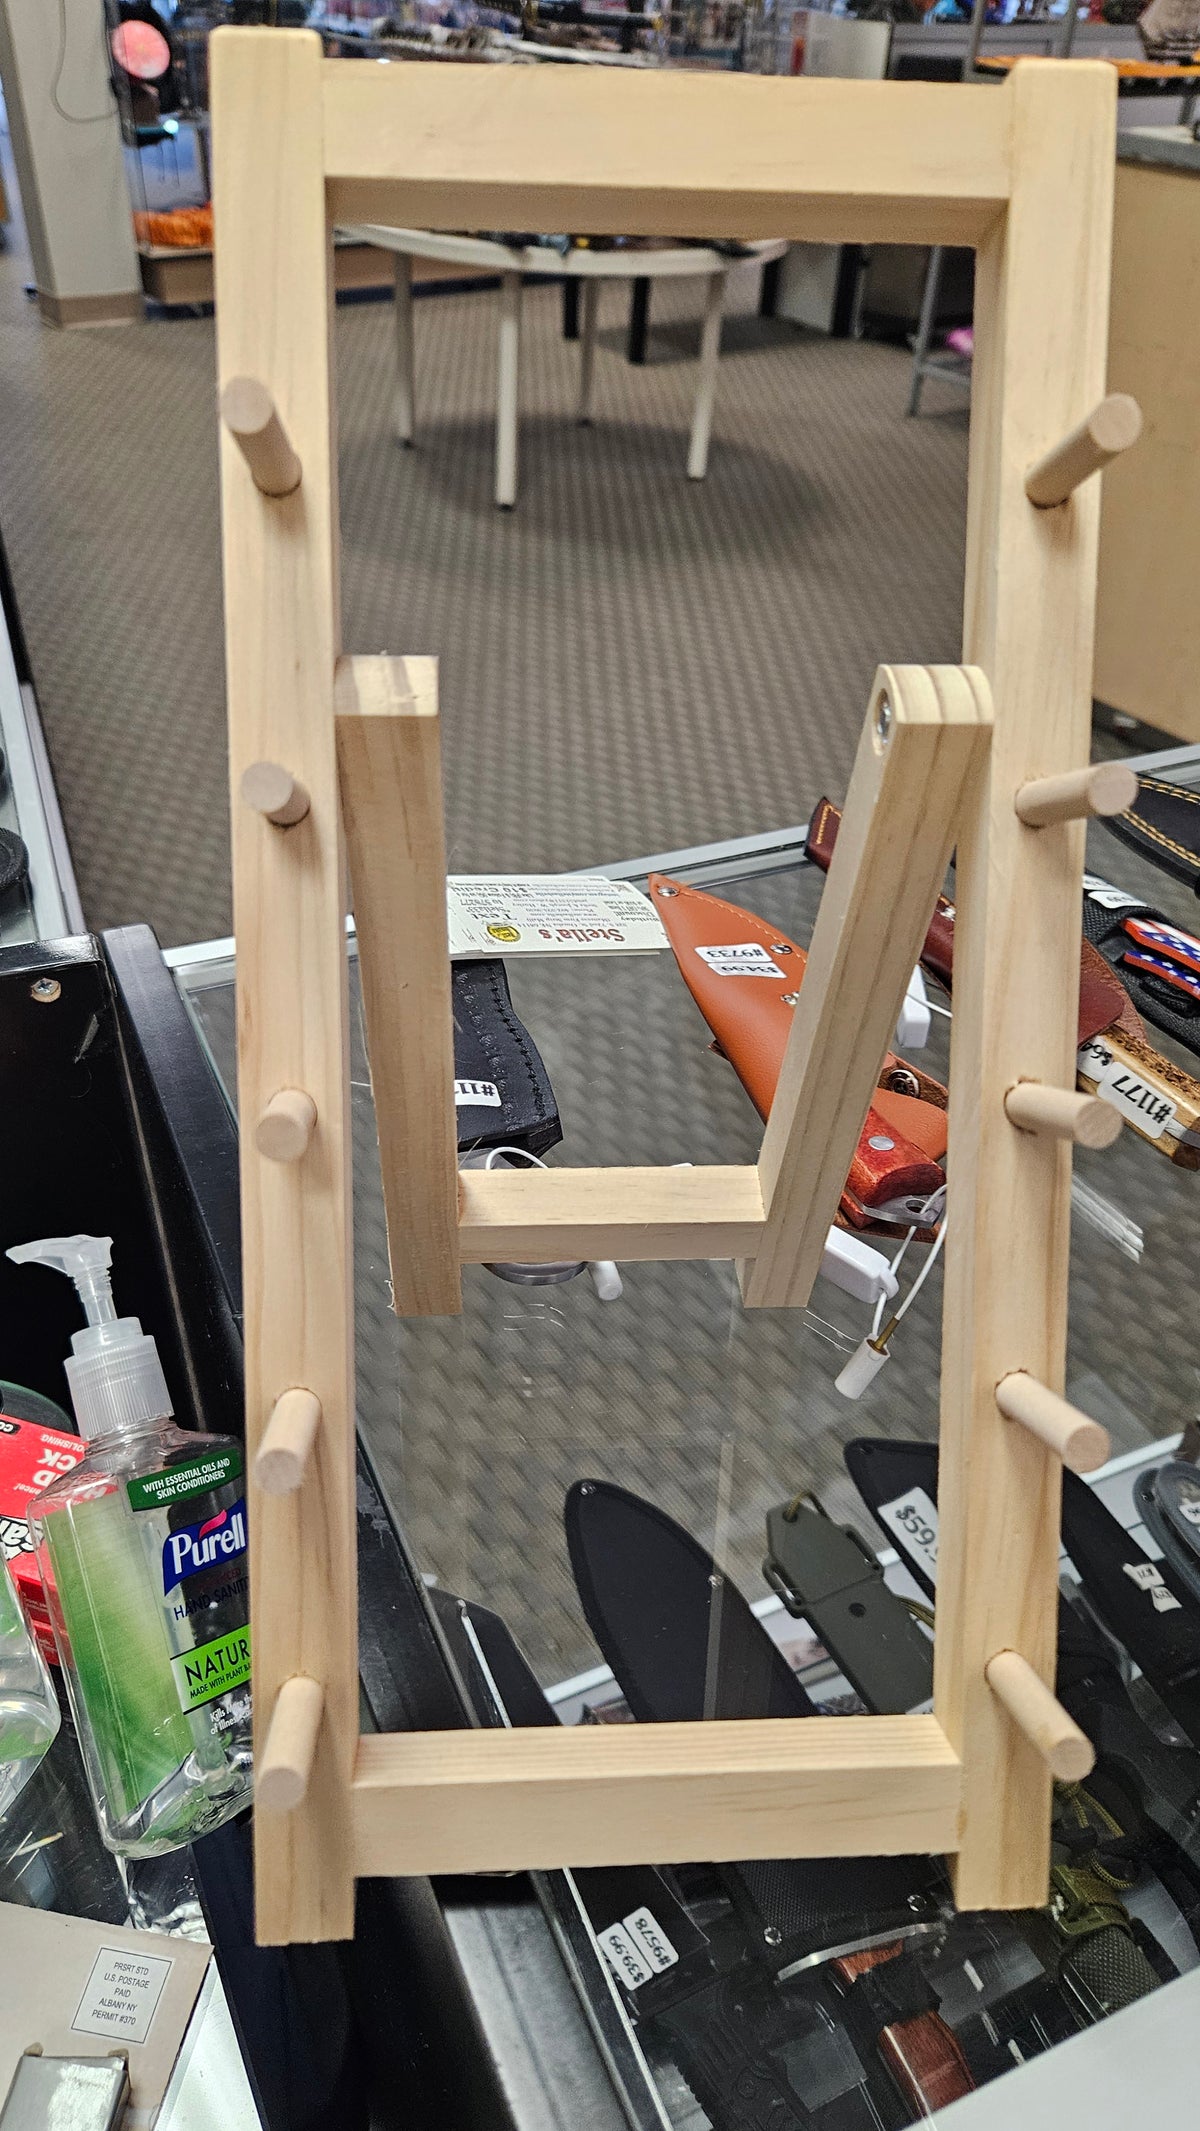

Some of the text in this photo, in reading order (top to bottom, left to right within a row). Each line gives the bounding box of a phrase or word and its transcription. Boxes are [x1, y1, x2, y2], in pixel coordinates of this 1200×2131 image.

[538, 928, 625, 943] Stella's
[706, 948, 763, 957] #9733
[721, 965, 779, 973] $34.99
[455, 1082, 496, 1096] #11
[1112, 1075, 1172, 1124] #1177
[41, 1434, 85, 1453] OLISHING
[142, 1458, 231, 1494] WITH ESSENTIAL OILS AND
[156, 1469, 226, 1500] SKIN CONDITIONERS
[169, 1512, 246, 1575] Purell
[174, 1594, 211, 1621] HAND
[184, 1638, 250, 1687] NATUR
[190, 1683, 208, 1699] MADE
[209, 1676, 226, 1690] WITH
[226, 1666, 243, 1681] PLANT
[210, 1707, 226, 1722] Kills
[634, 1918, 672, 1966] #9578
[609, 1935, 645, 1983] $39.99
[113, 1961, 149, 1976] PRSRT STD
[104, 1973, 150, 1988] U.S. POSTAGE
[113, 1987, 131, 1998] PAID
[98, 1998, 138, 2012] ALBANY NY
[92, 2009, 137, 2025] PERMIT #370
